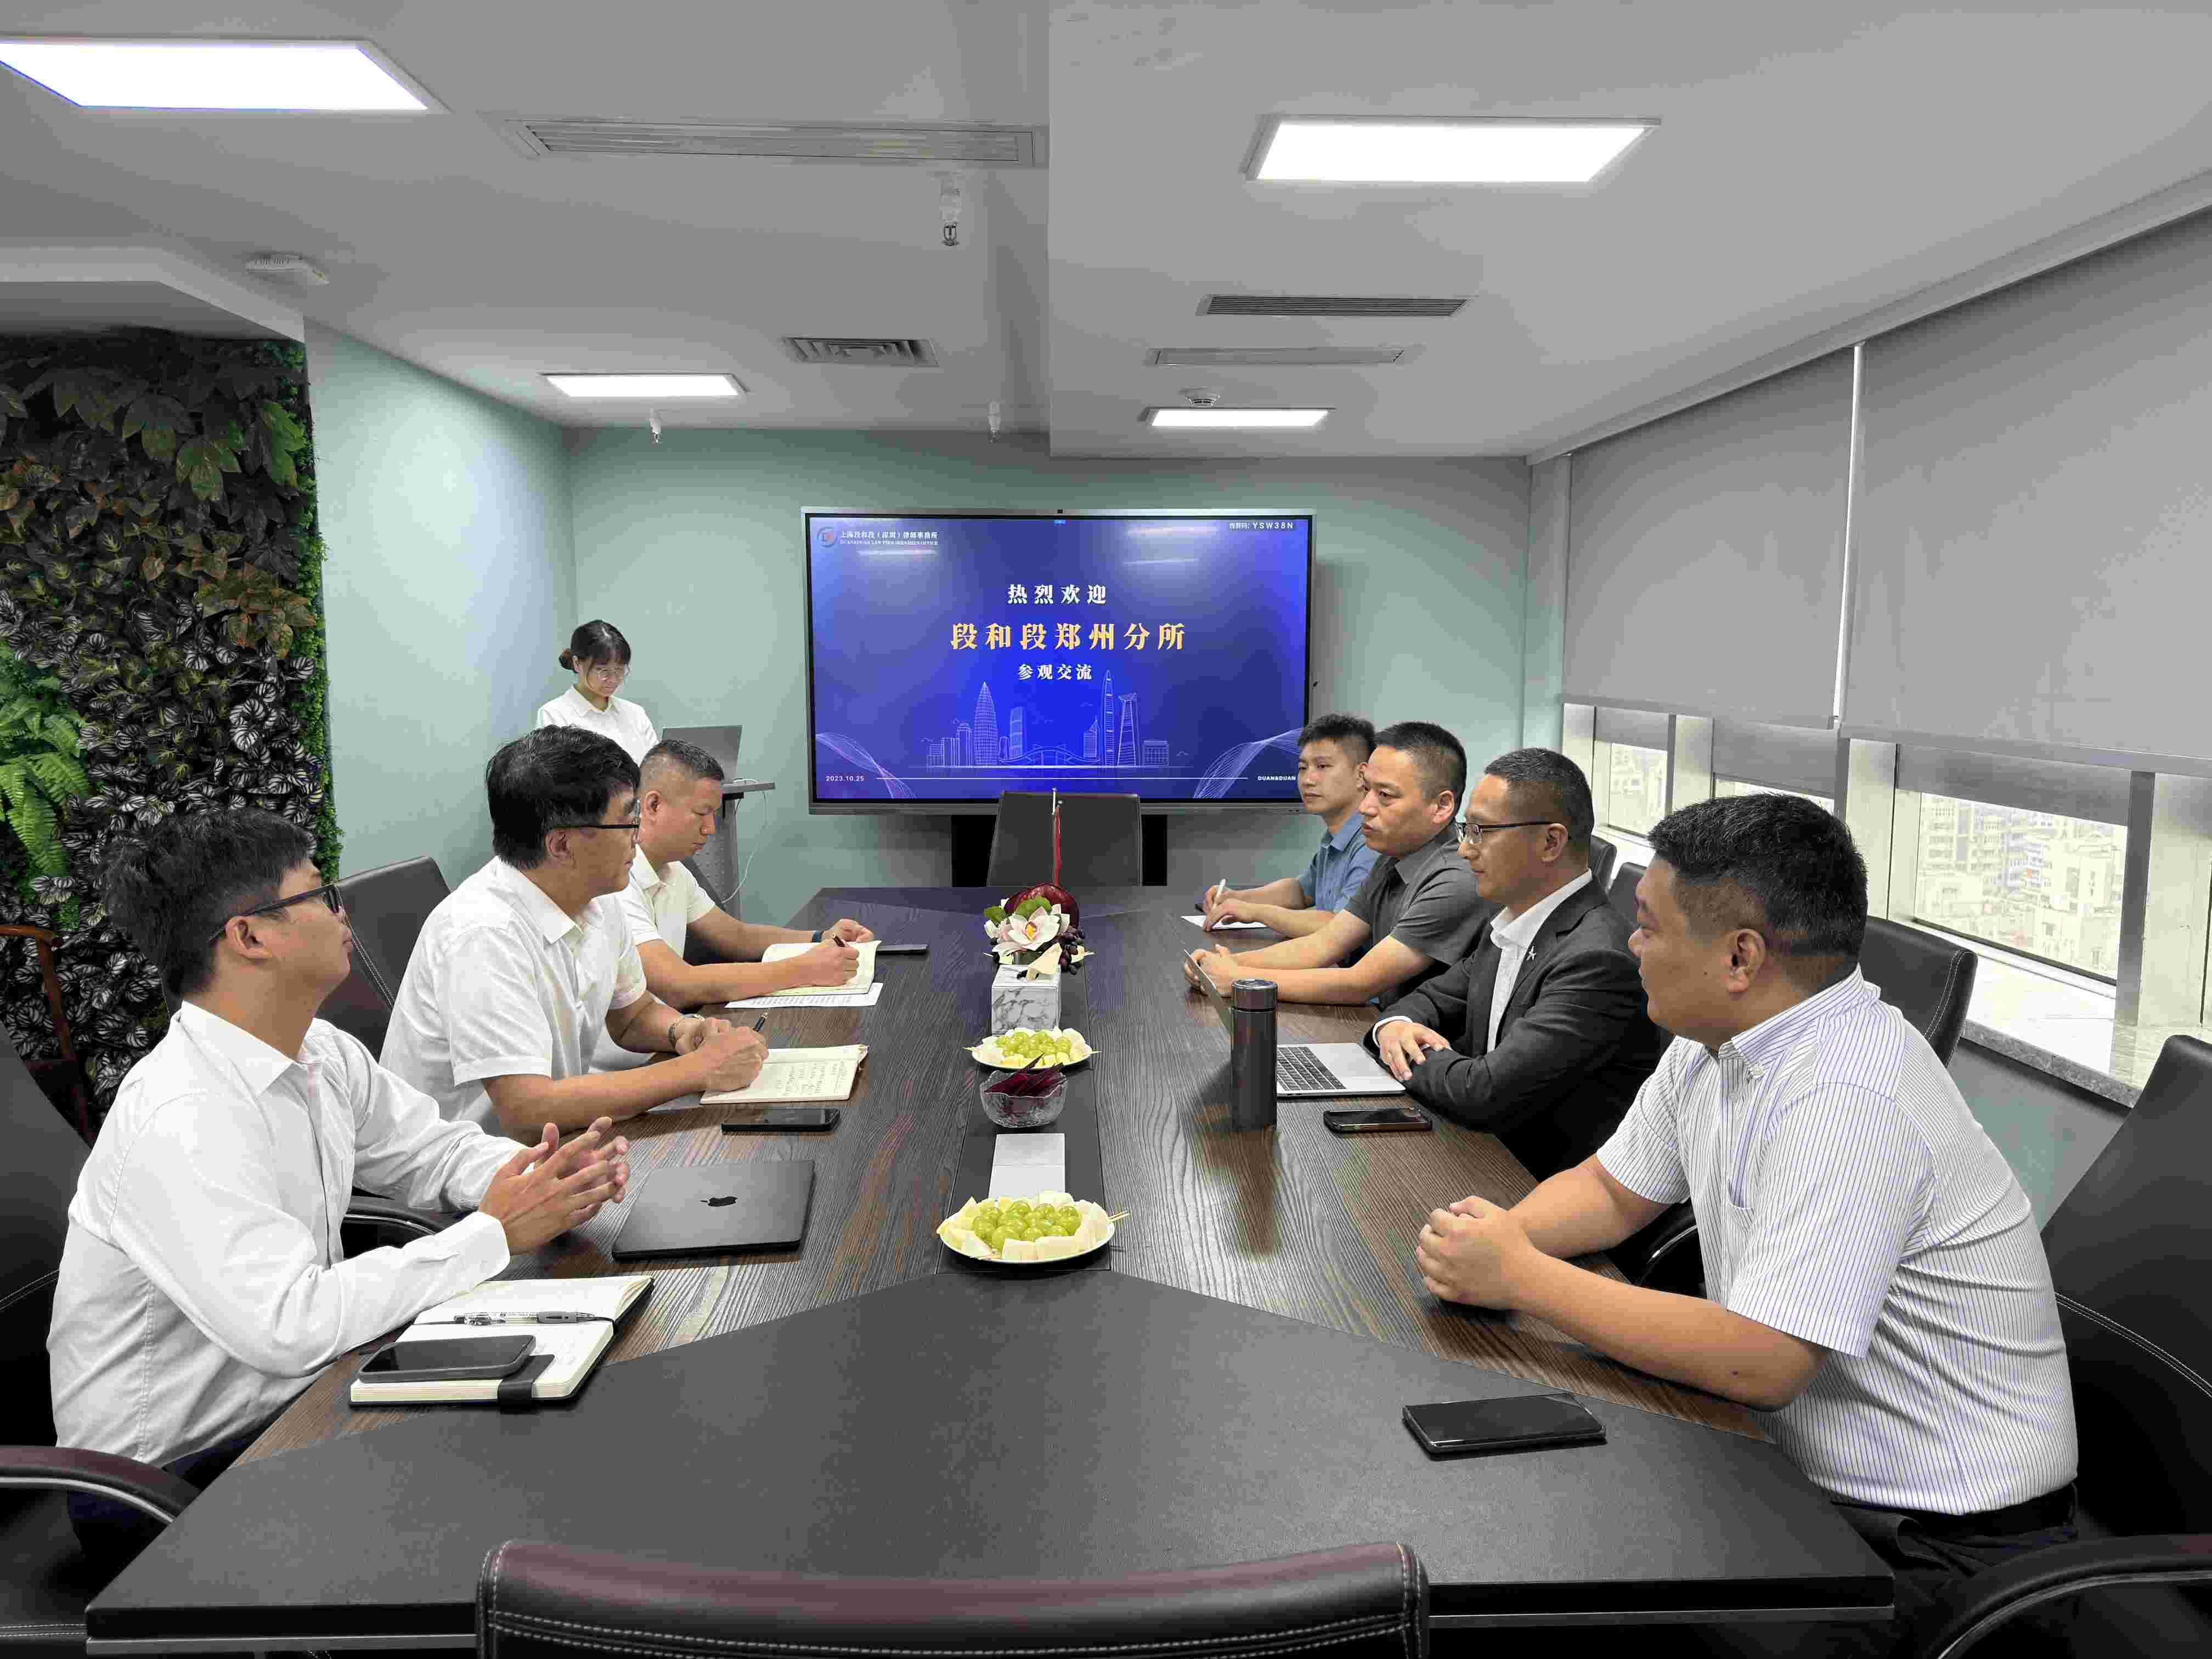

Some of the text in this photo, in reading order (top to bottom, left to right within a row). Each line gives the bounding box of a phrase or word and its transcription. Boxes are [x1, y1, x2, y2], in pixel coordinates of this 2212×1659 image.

[1008, 584, 1106, 604] 热烈欢迎
[950, 623, 1185, 650] 段和段郑州分所
[1018, 663, 1093, 680] 参观交流
